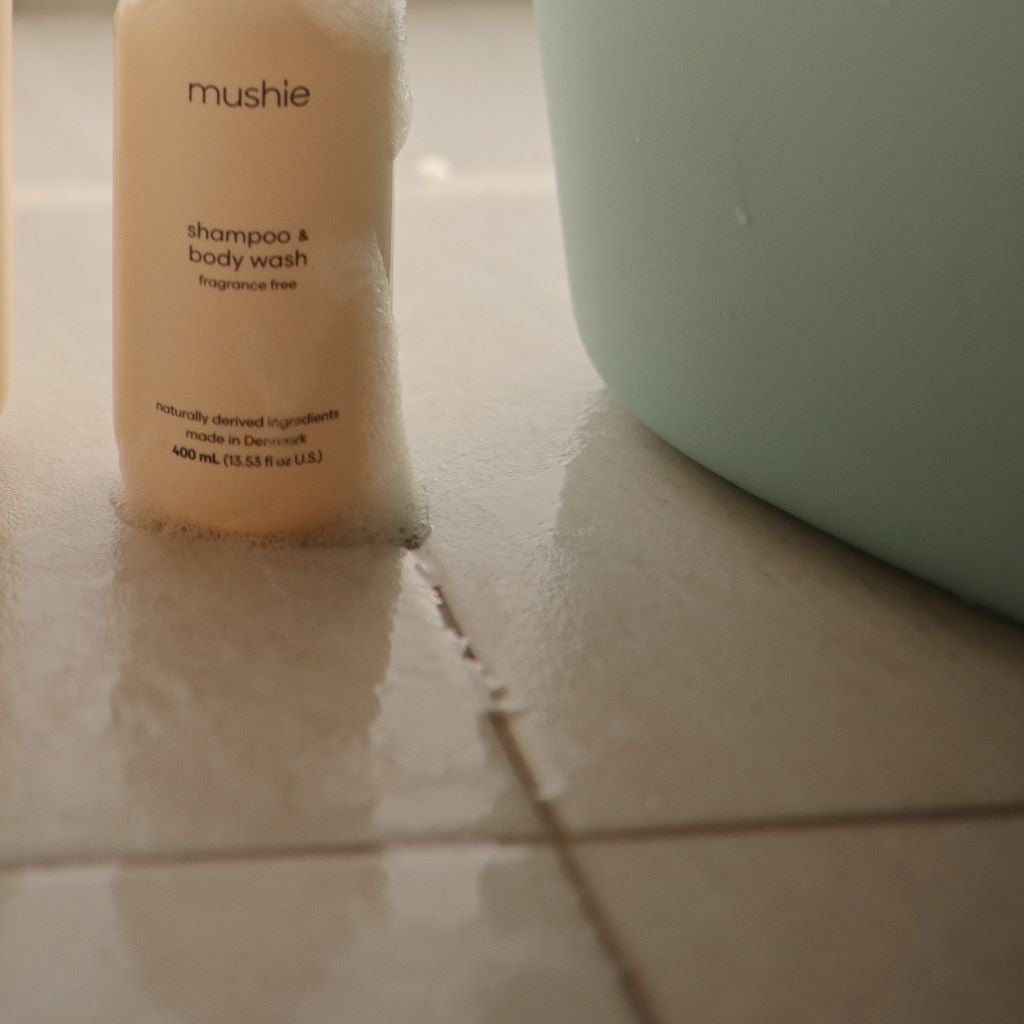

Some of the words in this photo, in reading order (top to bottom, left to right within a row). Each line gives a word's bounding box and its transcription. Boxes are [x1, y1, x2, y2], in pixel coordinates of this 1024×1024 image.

[188, 79, 310, 108] mushie
[187, 221, 291, 248] shampoo
[298, 228, 308, 242] &
[189, 244, 244, 272] body
[250, 249, 308, 268] wash
[199, 274, 267, 292] fragrance
[270, 279, 297, 290] free
[156, 401, 209, 425] naturally
[212, 414, 264, 428] derived
[267, 408, 339, 430] ingredients
[185, 429, 224, 444] made
[229, 434, 240, 444] in
[172, 444, 196, 460] 400
[199, 452, 219, 464] mL
[223, 454, 261, 467] (13.53
[264, 456, 273, 467] fl
[276, 456, 290, 467] oz
[294, 449, 322, 464] U.S.)
